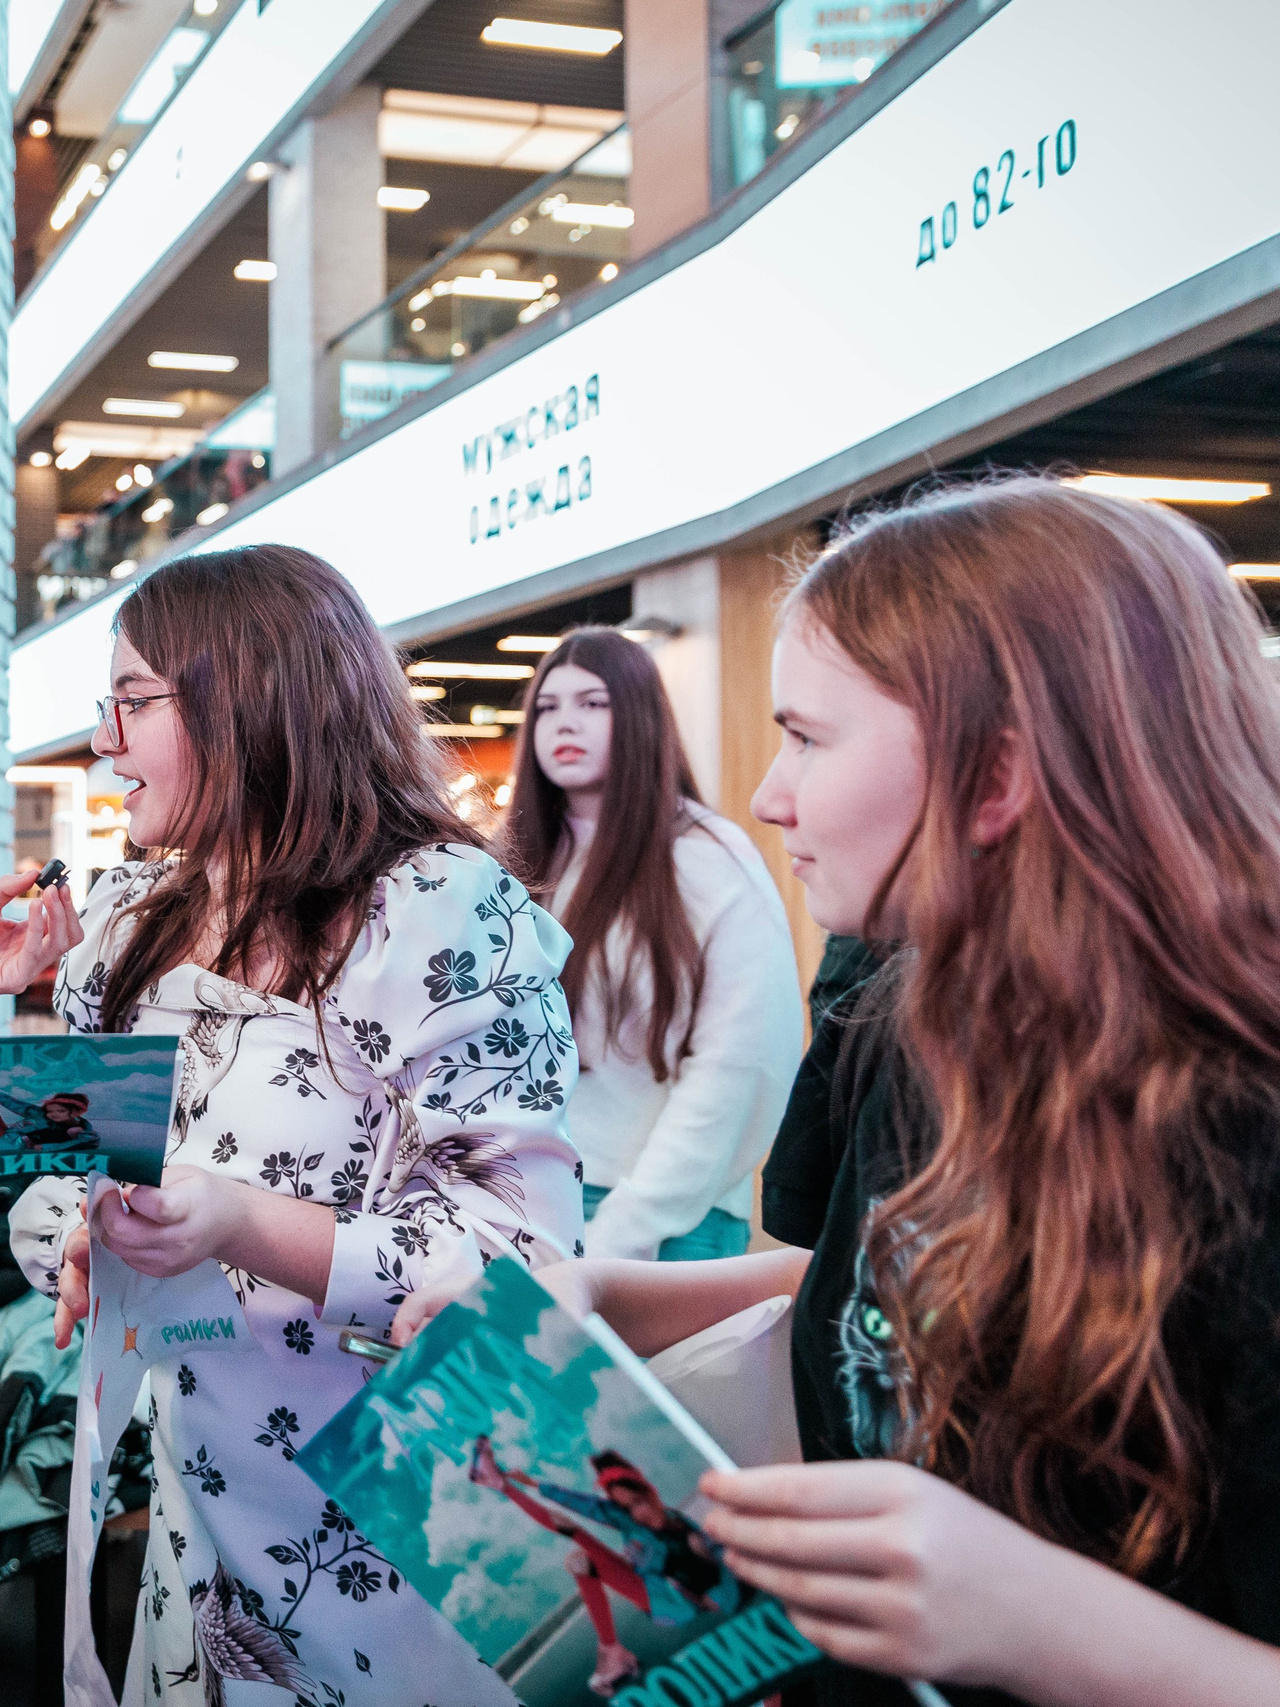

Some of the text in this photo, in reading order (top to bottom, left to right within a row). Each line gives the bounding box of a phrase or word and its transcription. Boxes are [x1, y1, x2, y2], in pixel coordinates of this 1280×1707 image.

[916, 118, 1077, 269] до 82-го
[462, 373, 600, 477] мужская
[469, 454, 592, 544] одежда
